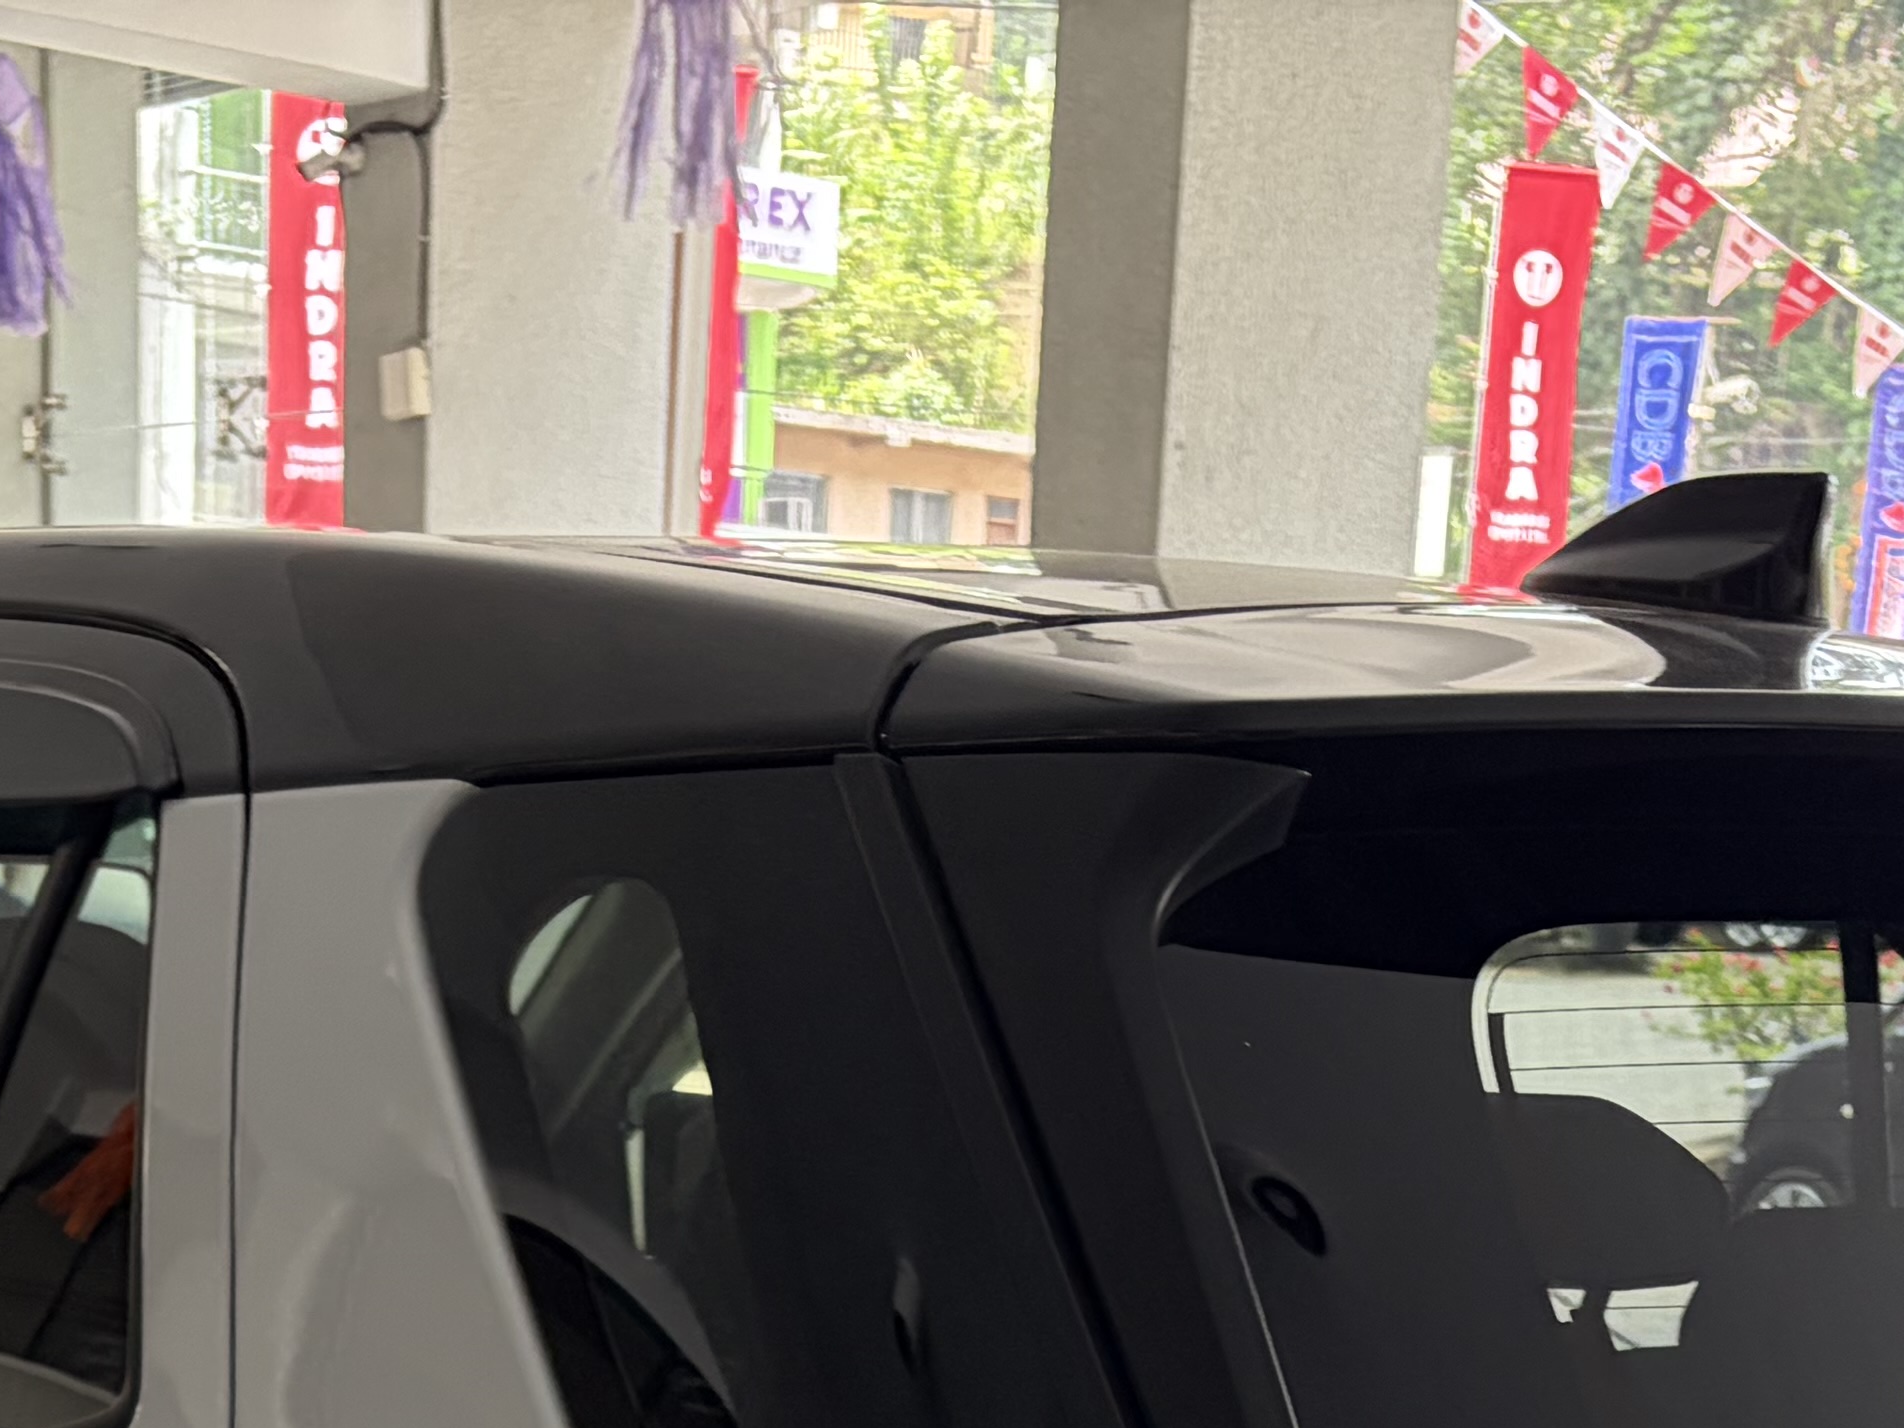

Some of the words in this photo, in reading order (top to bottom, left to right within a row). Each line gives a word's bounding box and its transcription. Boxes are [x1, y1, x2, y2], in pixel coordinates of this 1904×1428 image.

[304, 205, 344, 430] INDRA
[1630, 348, 1684, 463] CDB
[1504, 320, 1542, 501] INDRA
